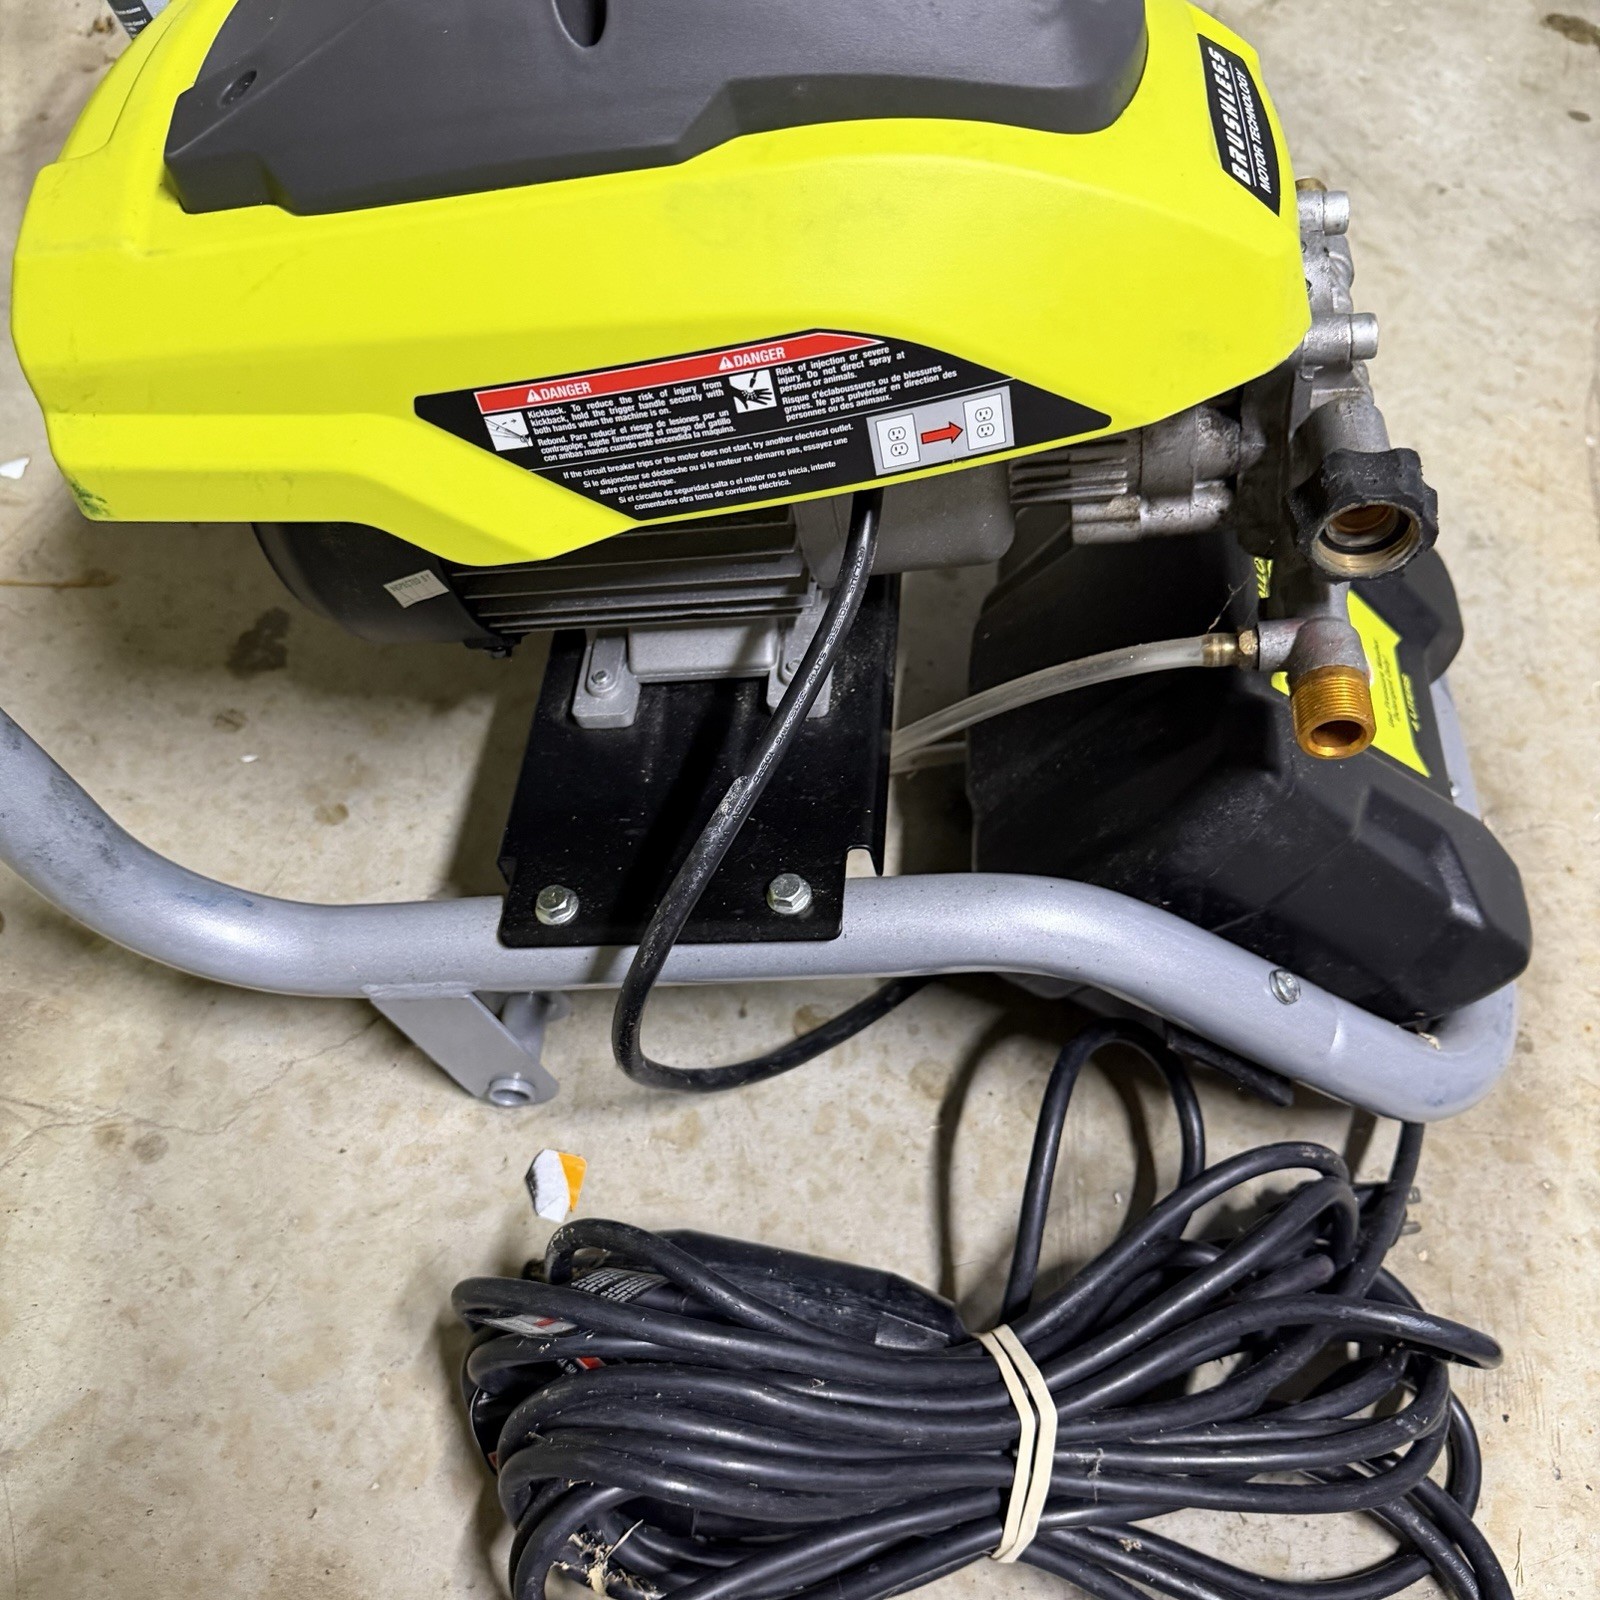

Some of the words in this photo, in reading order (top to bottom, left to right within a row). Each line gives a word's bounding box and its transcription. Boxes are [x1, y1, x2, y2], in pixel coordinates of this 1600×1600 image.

[1208, 46, 1252, 186] BRUSHLESS
[1234, 67, 1263, 145] TECHNOLOGY
[1252, 146, 1272, 194] MOTOR
[733, 346, 786, 367] DANGER
[775, 366, 794, 376] Risk
[798, 362, 806, 372] of
[810, 356, 846, 368] injection
[862, 347, 890, 358] severe
[777, 375, 803, 385] injury.
[806, 370, 819, 379] Do
[822, 367, 837, 376] not
[840, 360, 864, 372] direct
[868, 355, 892, 366] spray
[896, 351, 905, 360] at
[527, 407, 566, 419] Kickback.
[571, 404, 581, 412] To
[586, 400, 614, 410] reduce
[619, 396, 633, 404] the
[638, 392, 654, 402] risk
[659, 389, 668, 398] of
[673, 385, 697, 396] injury
[702, 381, 722, 390] from
[540, 382, 592, 400] DANGER
[780, 380, 812, 394] persons
[823, 372, 857, 384] animals.
[782, 393, 810, 405] Risque
[812, 380, 876, 400] d'éclaboussures
[890, 374, 901, 382] de
[903, 364, 942, 380] blessures
[784, 403, 813, 414] graves.
[815, 398, 826, 407] Ne
[830, 396, 845, 405] pas
[847, 386, 887, 402] pulvériser
[904, 374, 940, 388] direction
[942, 370, 958, 379] des
[530, 415, 569, 427] kickback,
[571, 411, 589, 420] hold
[592, 408, 606, 417] the
[608, 404, 635, 415] trigger
[638, 399, 666, 410] handle
[669, 393, 702, 405] securely
[706, 389, 724, 398] with
[533, 426, 552, 435] both
[552, 423, 577, 433] hands
[577, 420, 600, 428] when
[600, 416, 614, 424] the
[615, 412, 648, 422] machine
[659, 407, 672, 415] on.
[786, 408, 827, 422] personnes
[828, 405, 838, 413] ou
[840, 401, 854, 410] des
[855, 394, 892, 407] animaux.
[537, 436, 568, 447] Rebond.
[570, 434, 588, 442] Para
[591, 428, 616, 438] reducir
[620, 426, 628, 434] el
[630, 422, 653, 432] riesgo
[656, 419, 666, 427] de
[669, 415, 700, 425] lesiones
[702, 412, 716, 422] por
[541, 442, 587, 454] contragolpe,
[587, 438, 611, 448] sujete
[612, 431, 654, 442] firmemente
[666, 425, 691, 435] mango
[694, 422, 706, 430] del
[708, 418, 731, 428] gatillo
[558, 450, 583, 460] ambas
[584, 448, 609, 456] manos
[610, 442, 637, 452] cuando
[638, 439, 654, 448] esté
[654, 432, 693, 445] encendida
[701, 425, 736, 437] máquina.
[570, 470, 582, 479] the
[583, 467, 606, 476] circuit
[607, 463, 636, 473] breaker
[636, 459, 654, 468] trips
[663, 455, 676, 463] the
[677, 452, 699, 461] motor
[700, 449, 719, 458] does
[719, 446, 732, 454] not
[732, 444, 752, 452] start,
[753, 441, 764, 449] try
[765, 436, 793, 446] another
[794, 430, 829, 442] electrical
[830, 423, 854, 435] outlet.
[600, 474, 640, 486] disjoncteur
[651, 466, 688, 478] déclenche
[716, 456, 742, 466] moteur
[754, 449, 785, 460] démarre
[786, 447, 802, 456] pas,
[803, 441, 832, 452] essayez
[833, 437, 848, 446] une
[599, 486, 618, 495] autre
[619, 483, 638, 493] prise
[638, 478, 676, 490] électrique.
[634, 498, 678, 510] comentarios
[695, 492, 714, 501] toma
[714, 489, 724, 497] de
[725, 485, 758, 496] corriente
[758, 479, 791, 490] eléctrica.
[635, 490, 662, 502] circuito
[674, 482, 709, 495] seguridad
[710, 480, 728, 489] salta
[744, 474, 766, 483] motor
[787, 466, 810, 476] inicia,
[810, 461, 836, 472] intente
